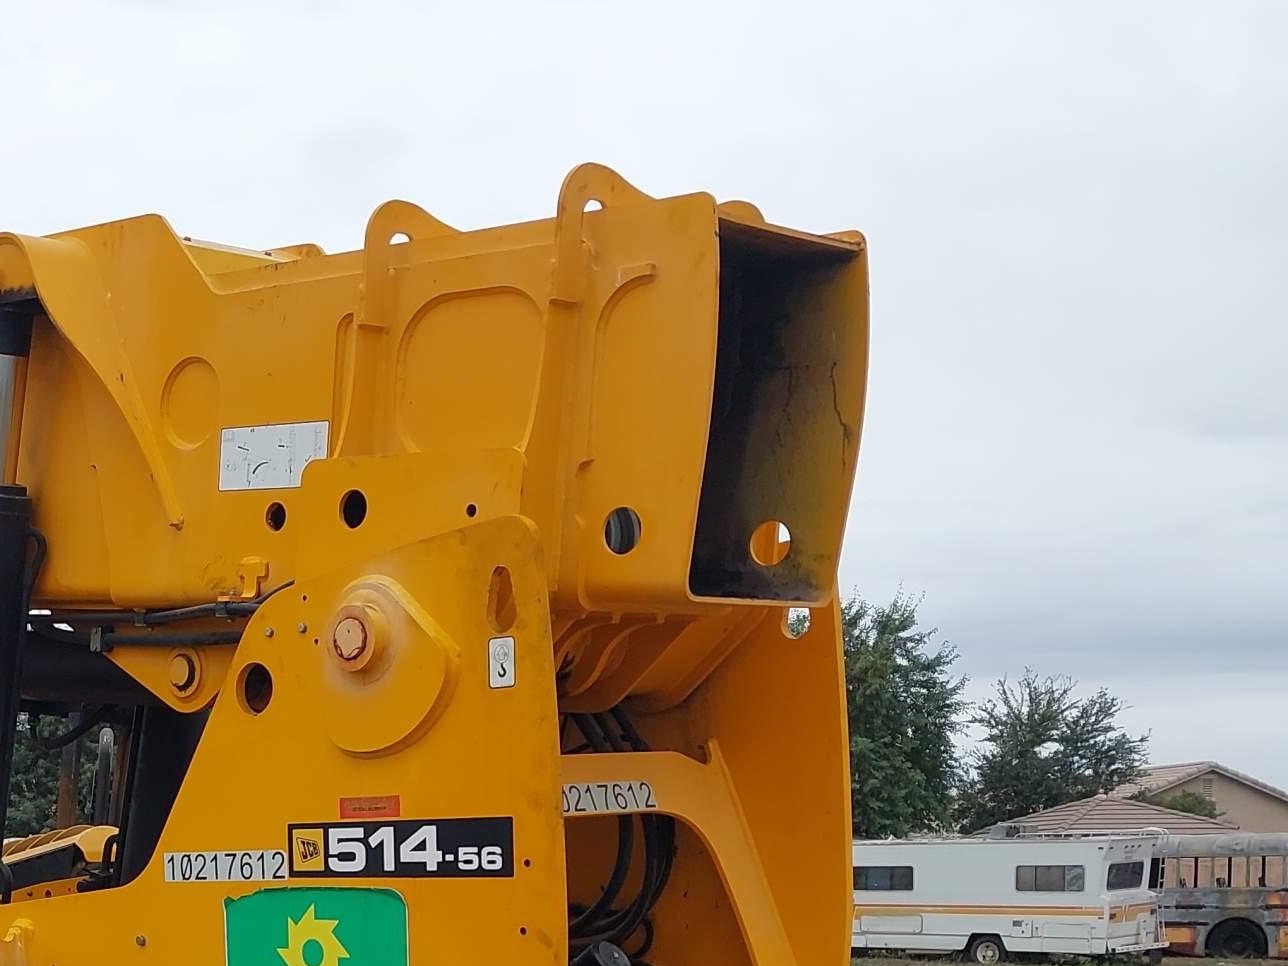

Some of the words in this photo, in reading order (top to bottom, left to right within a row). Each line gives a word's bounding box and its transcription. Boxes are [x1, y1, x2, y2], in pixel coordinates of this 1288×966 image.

[298, 838, 320, 864] JCB
[327, 825, 503, 872] 514-56
[167, 851, 285, 881] 10217612
